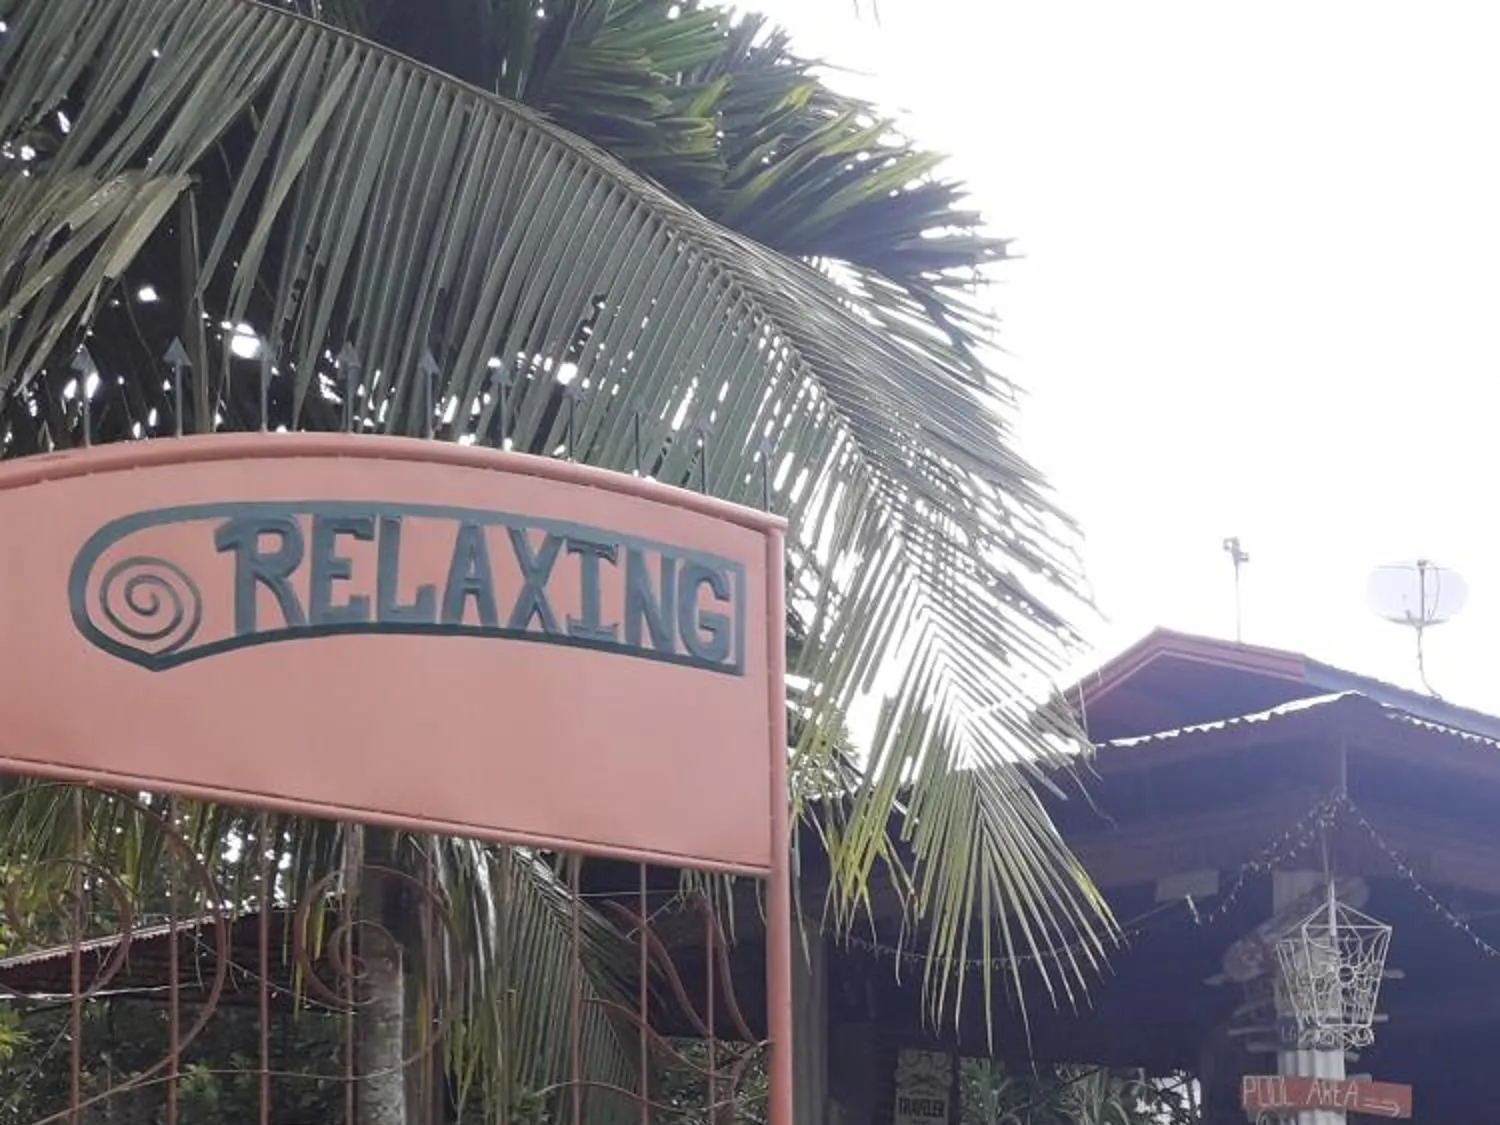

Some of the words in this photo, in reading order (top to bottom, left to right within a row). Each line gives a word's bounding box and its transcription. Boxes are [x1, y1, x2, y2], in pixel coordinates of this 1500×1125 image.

[215, 513, 732, 662] RELAXING
[1243, 1075, 1292, 1107] POOL
[1306, 1080, 1359, 1107] AREA
